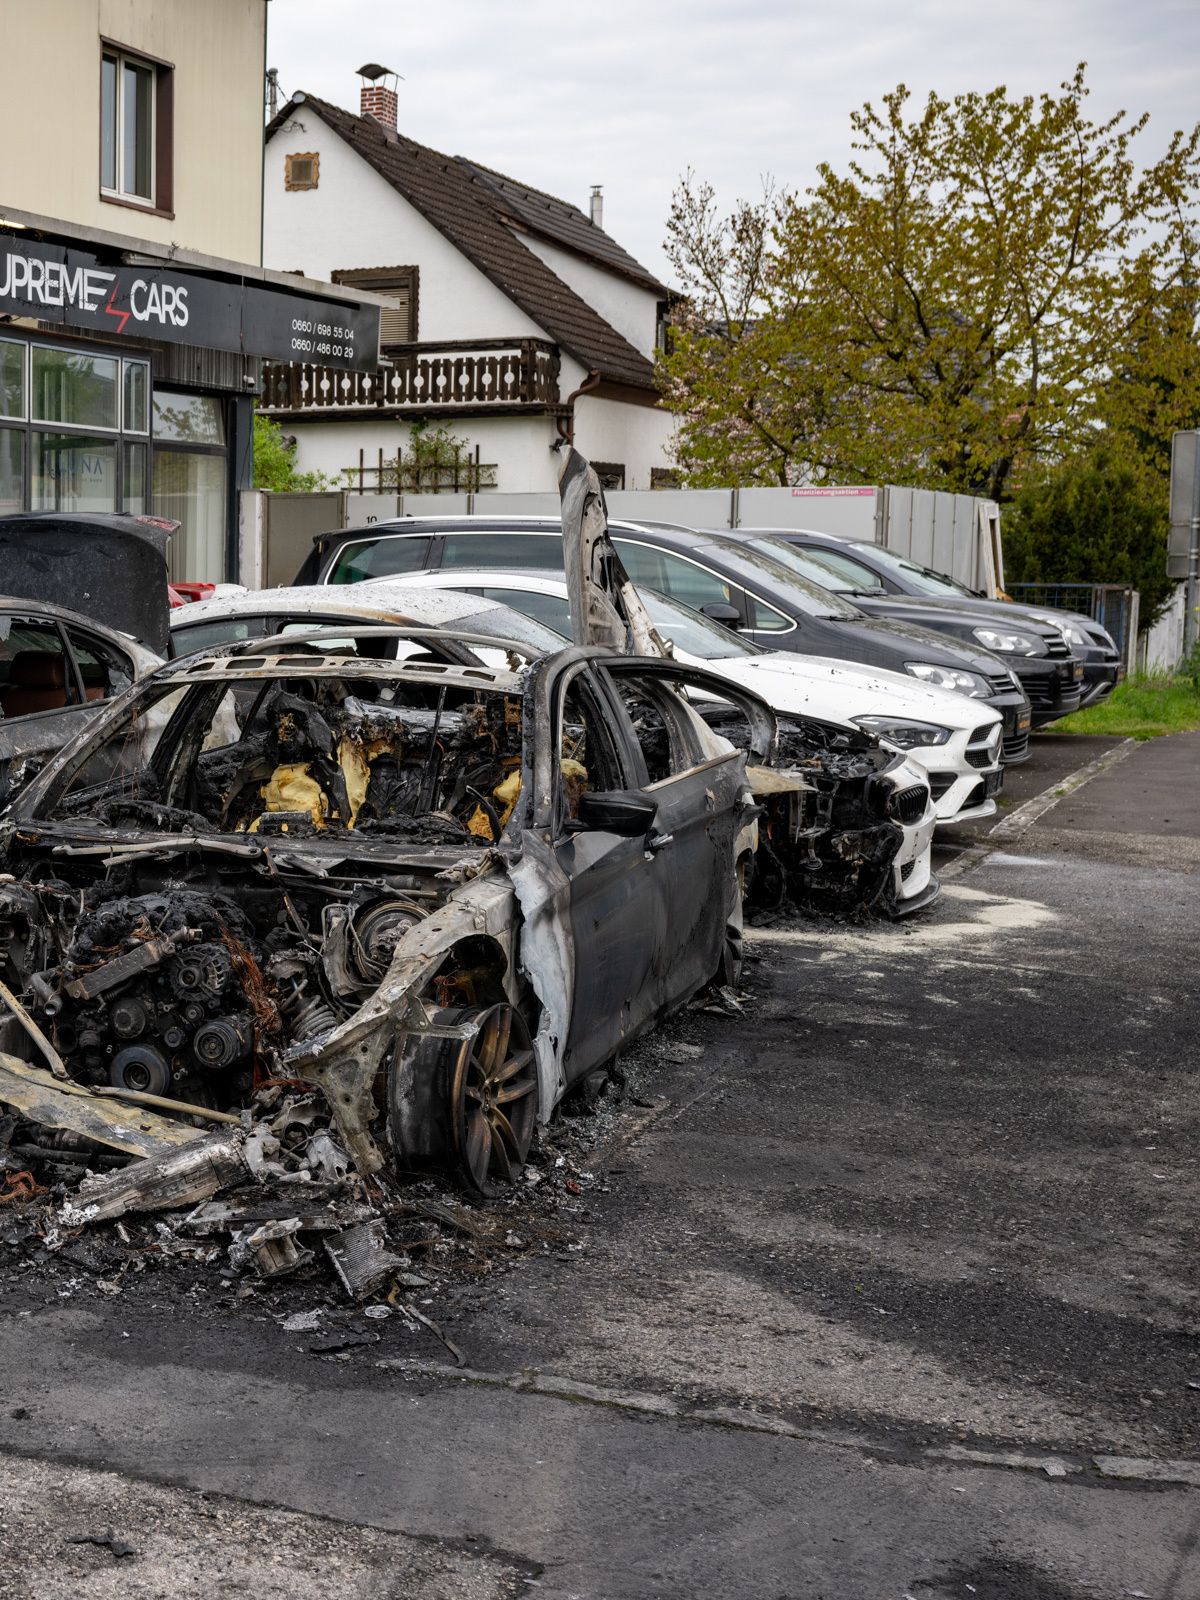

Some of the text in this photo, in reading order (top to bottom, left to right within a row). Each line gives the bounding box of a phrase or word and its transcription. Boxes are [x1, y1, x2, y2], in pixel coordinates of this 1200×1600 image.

[130, 279, 189, 327] CARS
[291, 319, 312, 333] 0660
[333, 326, 343, 338] 55
[344, 328, 355, 340] 04
[291, 338, 311, 352] 0660
[316, 342, 331, 355] 486
[332, 344, 343, 356] 00
[343, 346, 354, 359] 29
